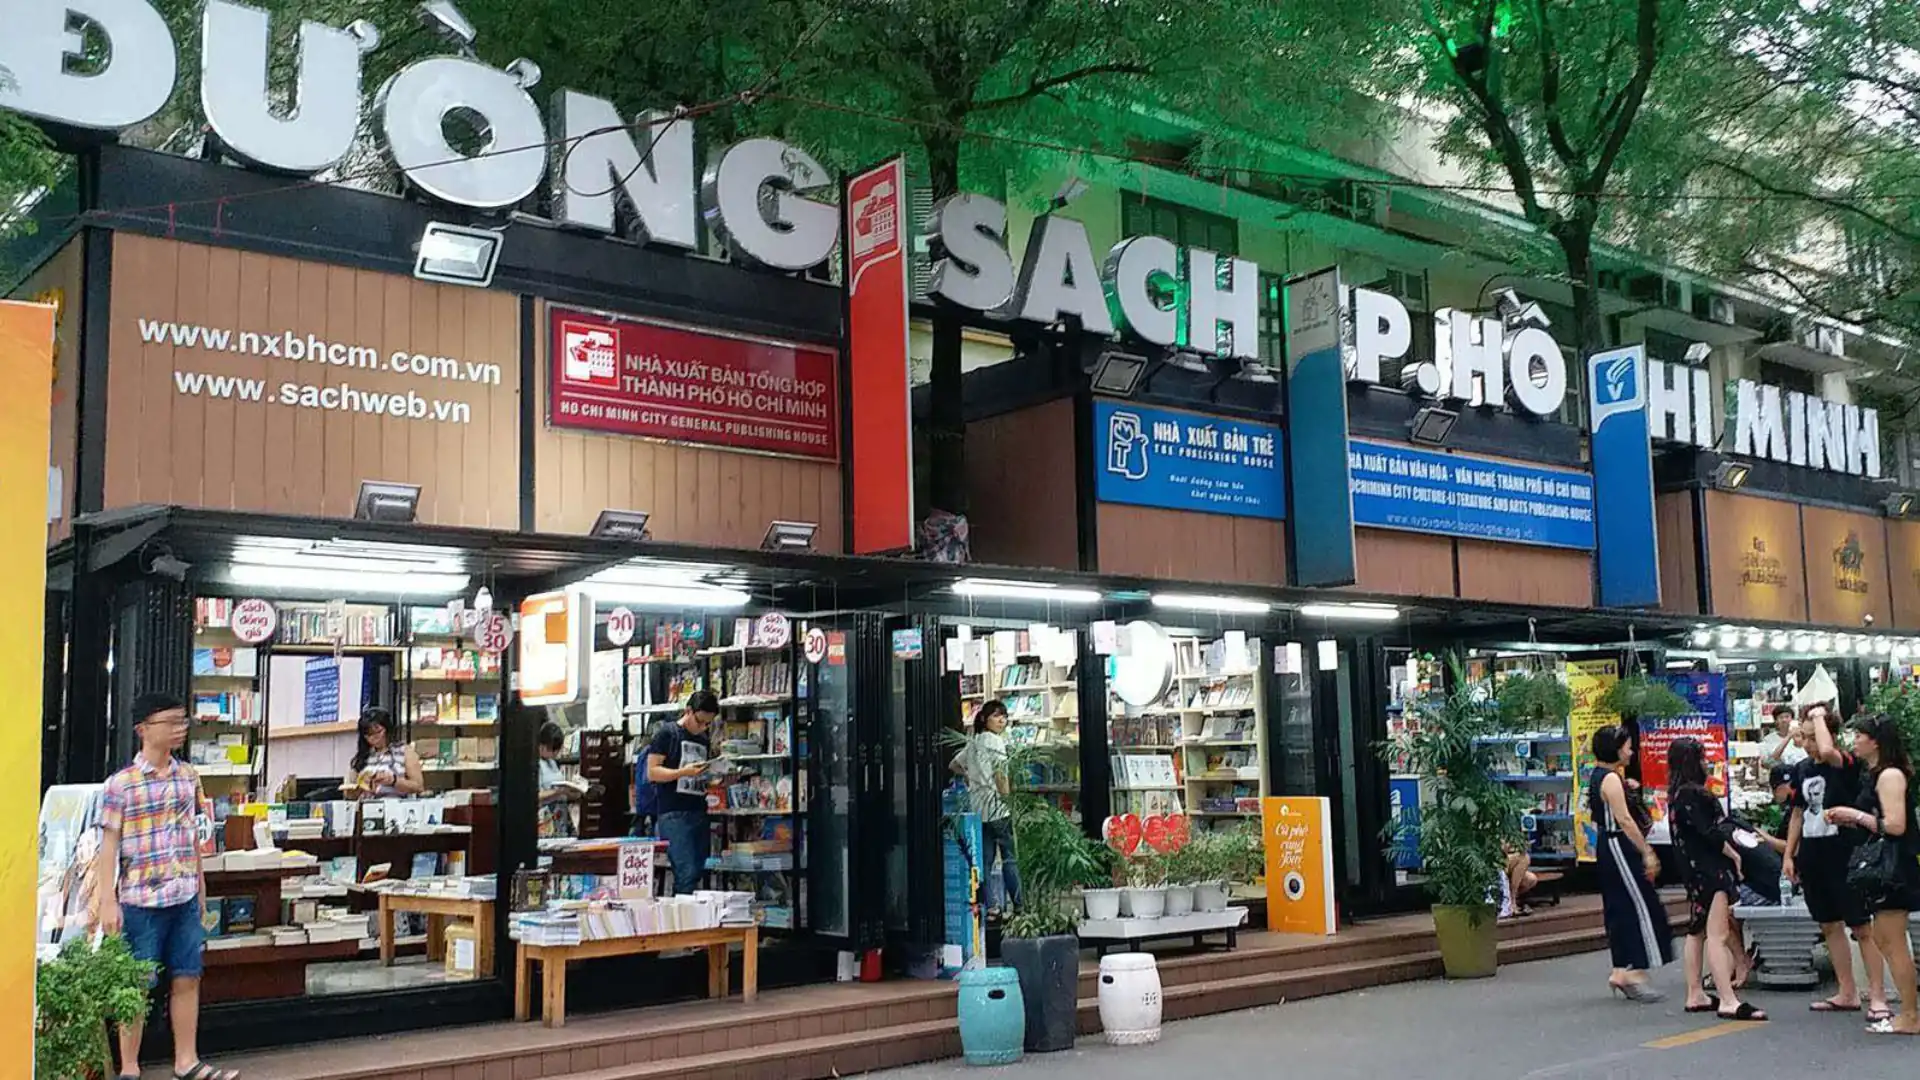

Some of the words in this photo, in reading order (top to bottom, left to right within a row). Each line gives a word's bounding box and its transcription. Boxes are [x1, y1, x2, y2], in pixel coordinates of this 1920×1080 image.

[0, 0, 839, 270] ĐƯỜNG
[929, 178, 1259, 360] SÁCH
[1735, 378, 1881, 478] MINH
[139, 318, 502, 386] www.nxbhcm.com.vn
[625, 354, 662, 372] NHÀ
[666, 360, 709, 381] XUẤT
[712, 365, 745, 386] BẢN
[749, 368, 793, 392] TỔNG
[796, 378, 826, 398] HỢP
[174, 370, 471, 423] www.sachweb.vn
[623, 374, 686, 400] THÀNH
[688, 380, 726, 405] PHỐ
[728, 386, 753, 409] HỒ
[755, 392, 784, 413] CHÍ
[786, 400, 828, 419] MINH
[581, 403, 603, 418] CHI
[605, 406, 640, 422] MINH
[641, 411, 668, 426] CITY
[671, 414, 723, 433] GENERAL
[725, 421, 792, 442] PUBLISHING
[793, 431, 828, 446] HOUSE
[1153, 420, 1181, 444] NHÀ
[1187, 424, 1219, 449] XUẤT
[1223, 427, 1248, 453] BẢN
[1253, 433, 1274, 456] TRẺ
[1393, 483, 1412, 500] CITY
[1571, 483, 1592, 501] MINH
[806, 634, 823, 654] 30
[623, 870, 649, 889] biệt
[624, 855, 649, 871] đặc
